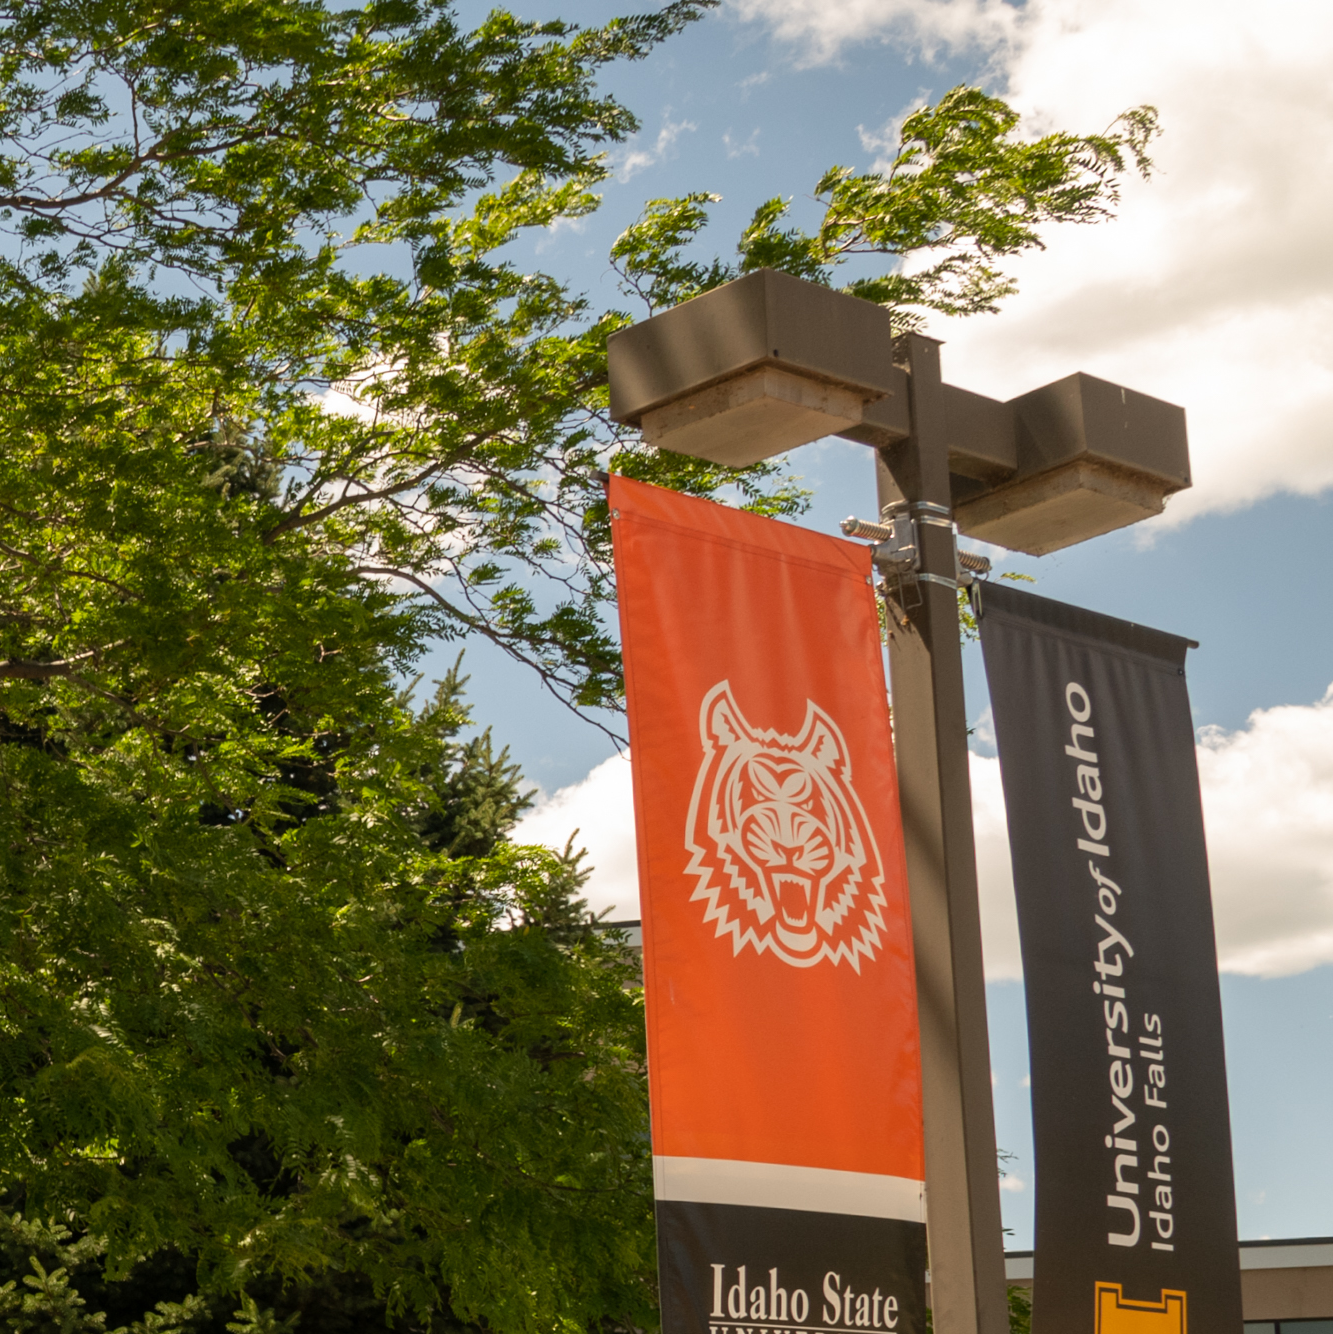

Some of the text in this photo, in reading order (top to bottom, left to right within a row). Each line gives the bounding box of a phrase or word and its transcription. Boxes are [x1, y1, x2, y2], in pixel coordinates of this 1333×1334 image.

[1065, 682, 1142, 1248] University of Idaho
[1138, 1013, 1175, 1252] Idaho Falls
[710, 1263, 899, 1329] Idaho State
